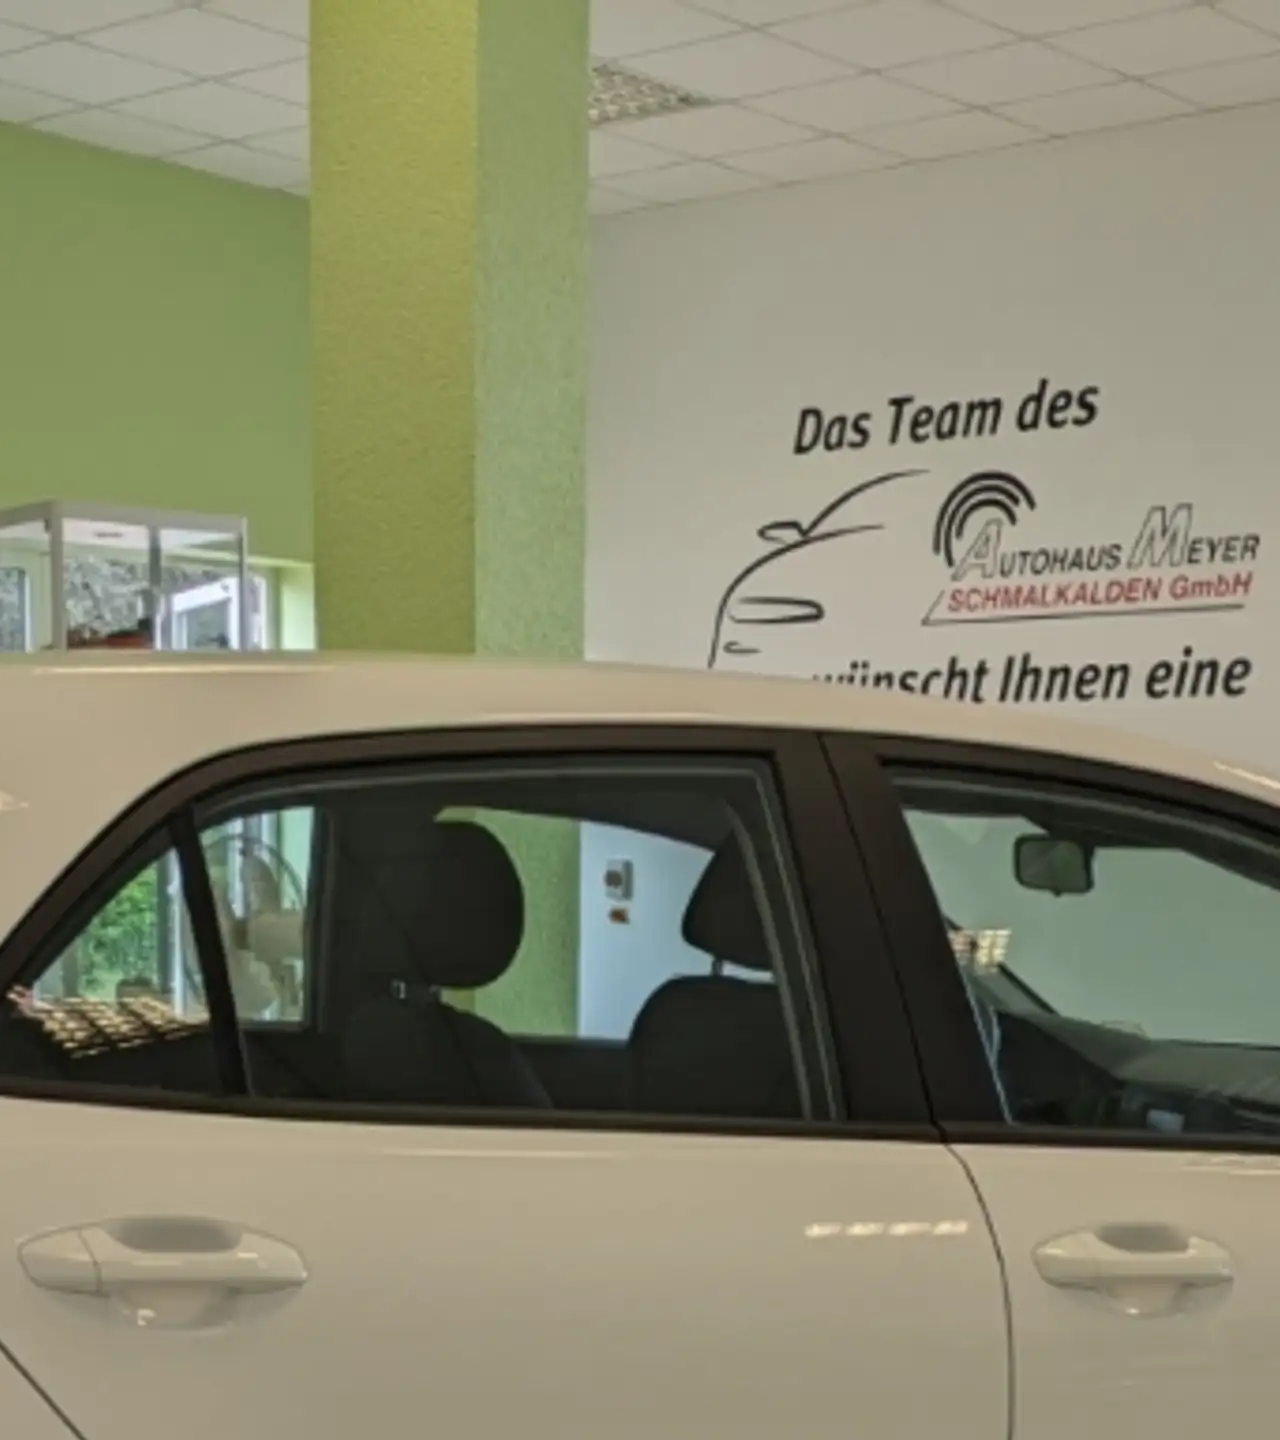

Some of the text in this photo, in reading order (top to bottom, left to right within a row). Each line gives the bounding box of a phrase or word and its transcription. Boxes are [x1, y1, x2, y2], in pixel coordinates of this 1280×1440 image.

[793, 378, 1099, 455] Das Team des
[951, 503, 1260, 582] AUTOHAUS MEYER
[948, 571, 1254, 613] SCHMALKALDEN GmbH
[812, 656, 990, 704] ünscht
[998, 653, 1131, 702] Ihnen
[1145, 646, 1252, 699] eine
